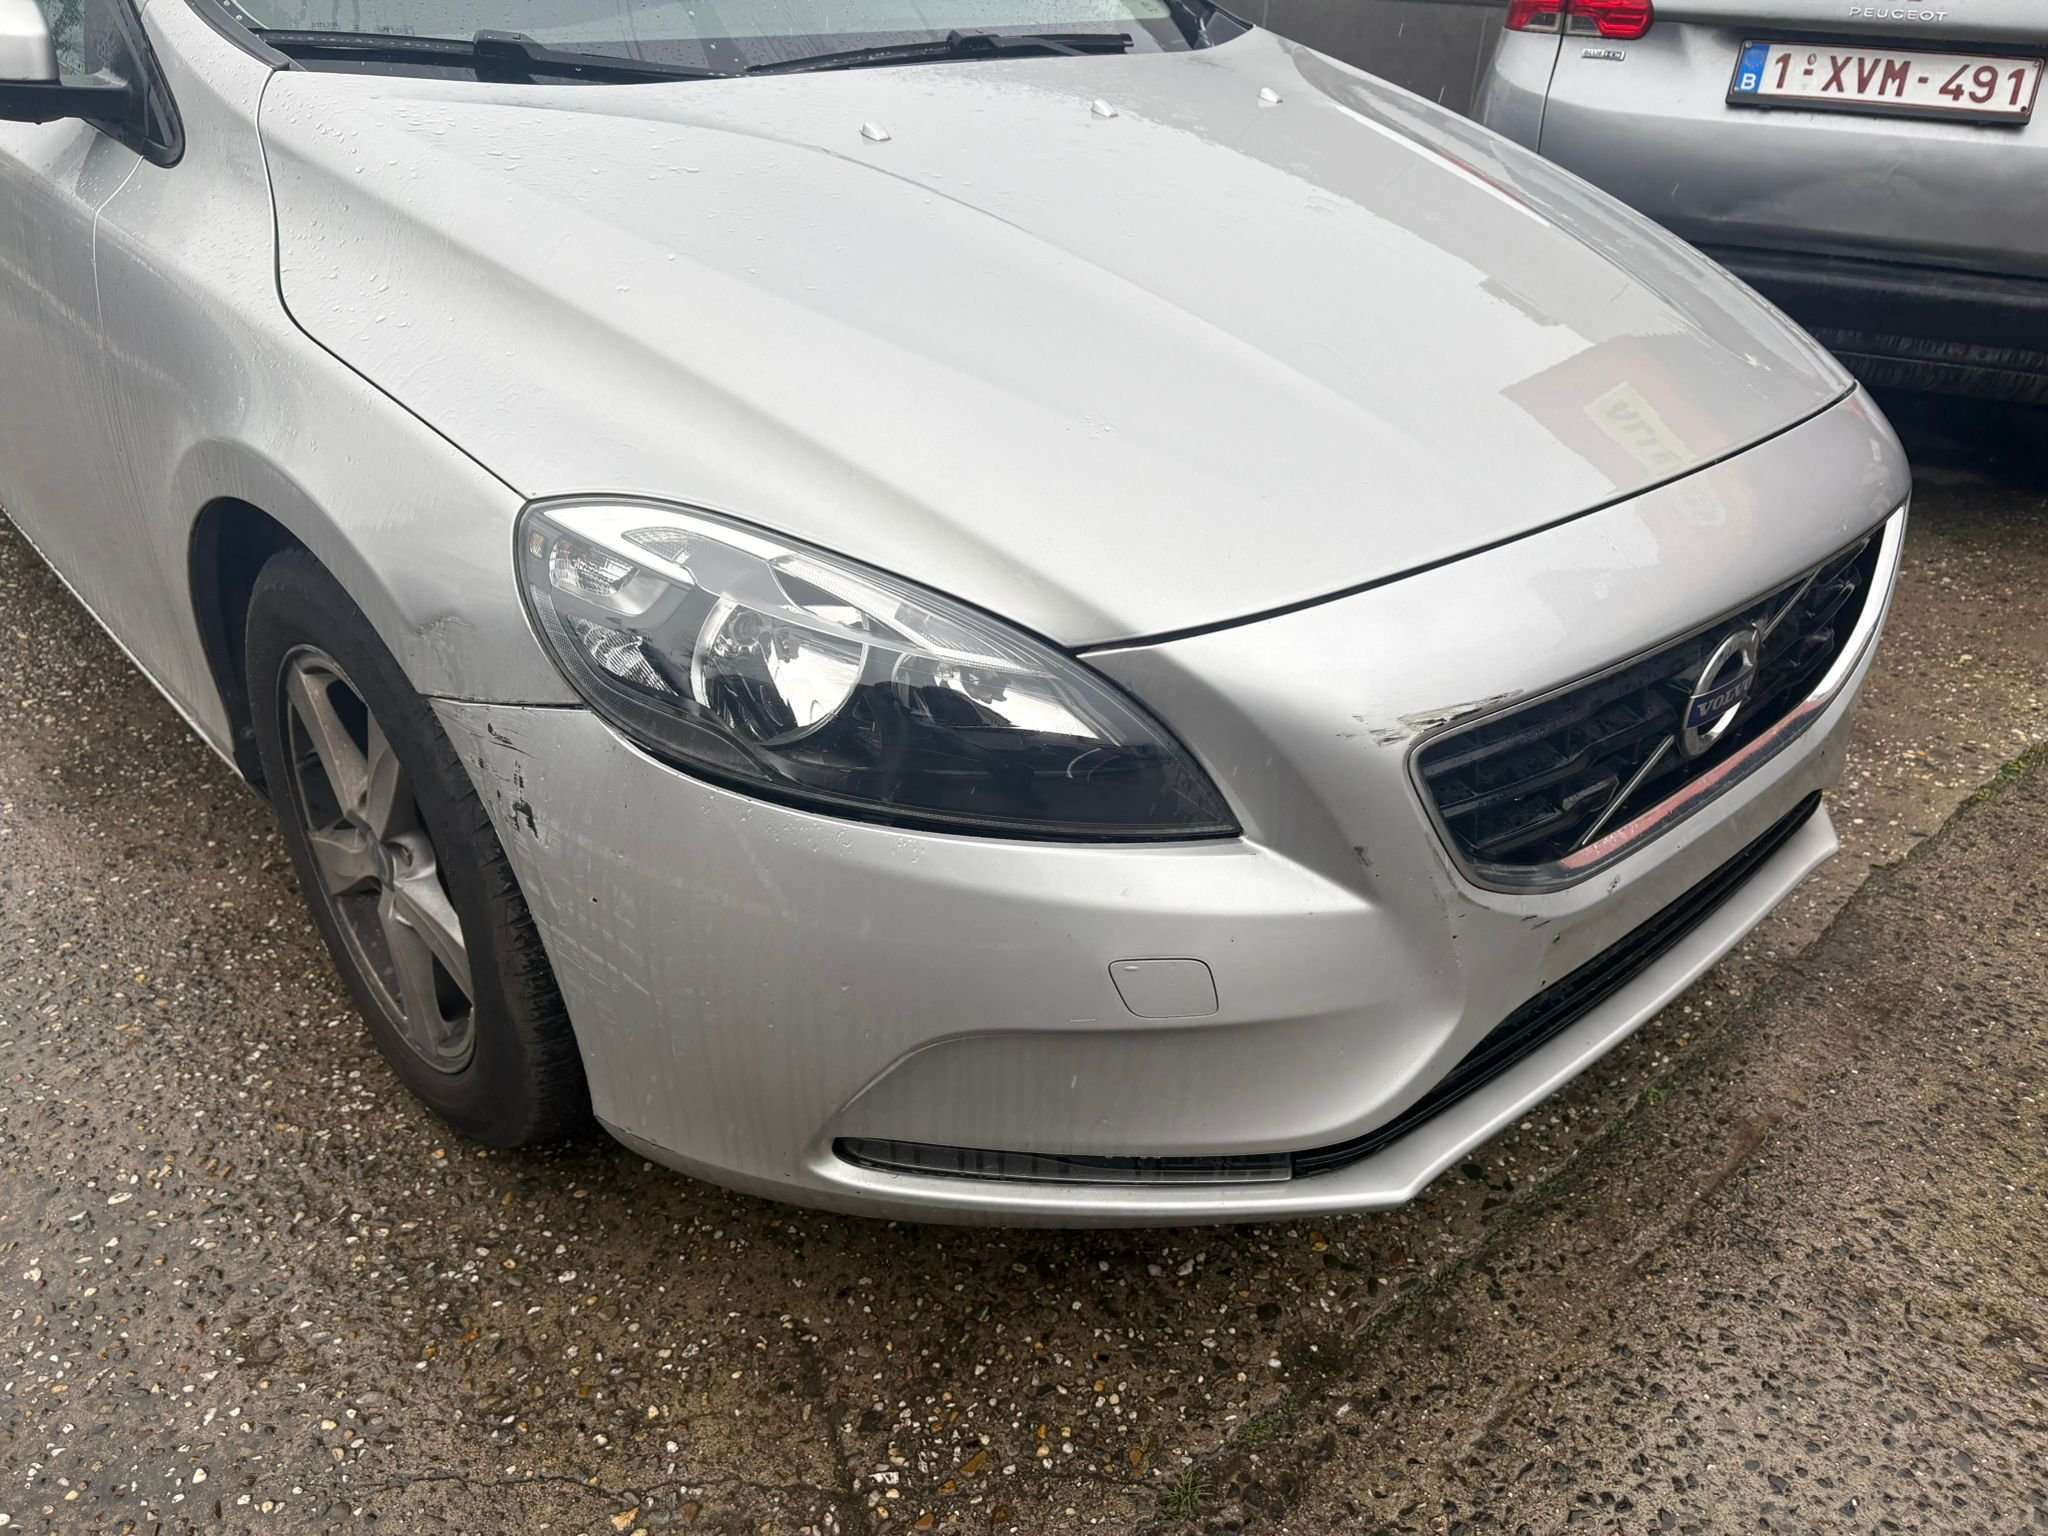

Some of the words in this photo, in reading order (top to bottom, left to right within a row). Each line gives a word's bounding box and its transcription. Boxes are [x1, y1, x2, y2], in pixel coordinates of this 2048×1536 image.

[1848, 6, 1948, 21] PEUGEOT
[1741, 73, 1757, 90] B
[1775, 53, 2027, 106] 1-XVM-491
